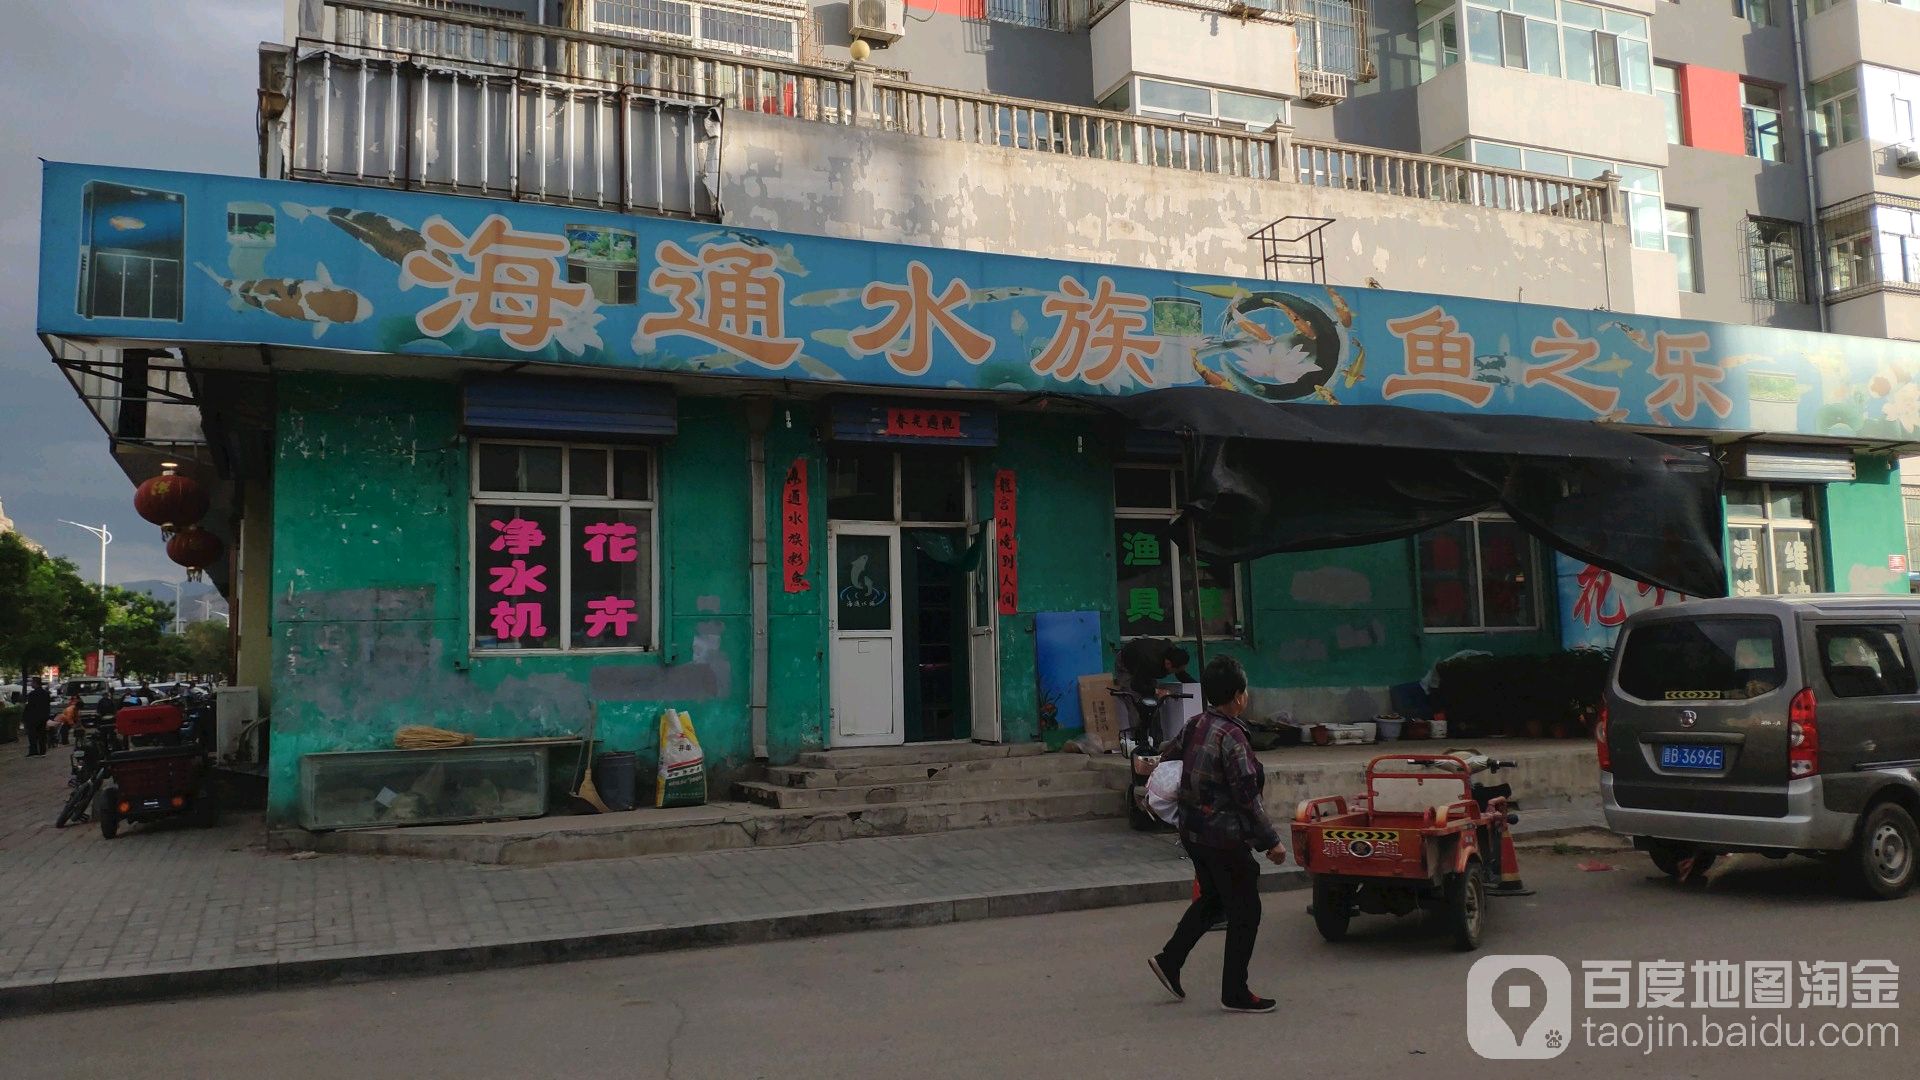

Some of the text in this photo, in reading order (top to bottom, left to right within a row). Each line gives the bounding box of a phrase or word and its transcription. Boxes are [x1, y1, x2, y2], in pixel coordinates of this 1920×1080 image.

[402, 213, 1163, 388] 海通水族
[1381, 305, 1734, 421] 鱼之乐
[489, 518, 547, 639] 净水机
[583, 522, 638, 637] 花卉
[1122, 531, 1165, 623] 渔具
